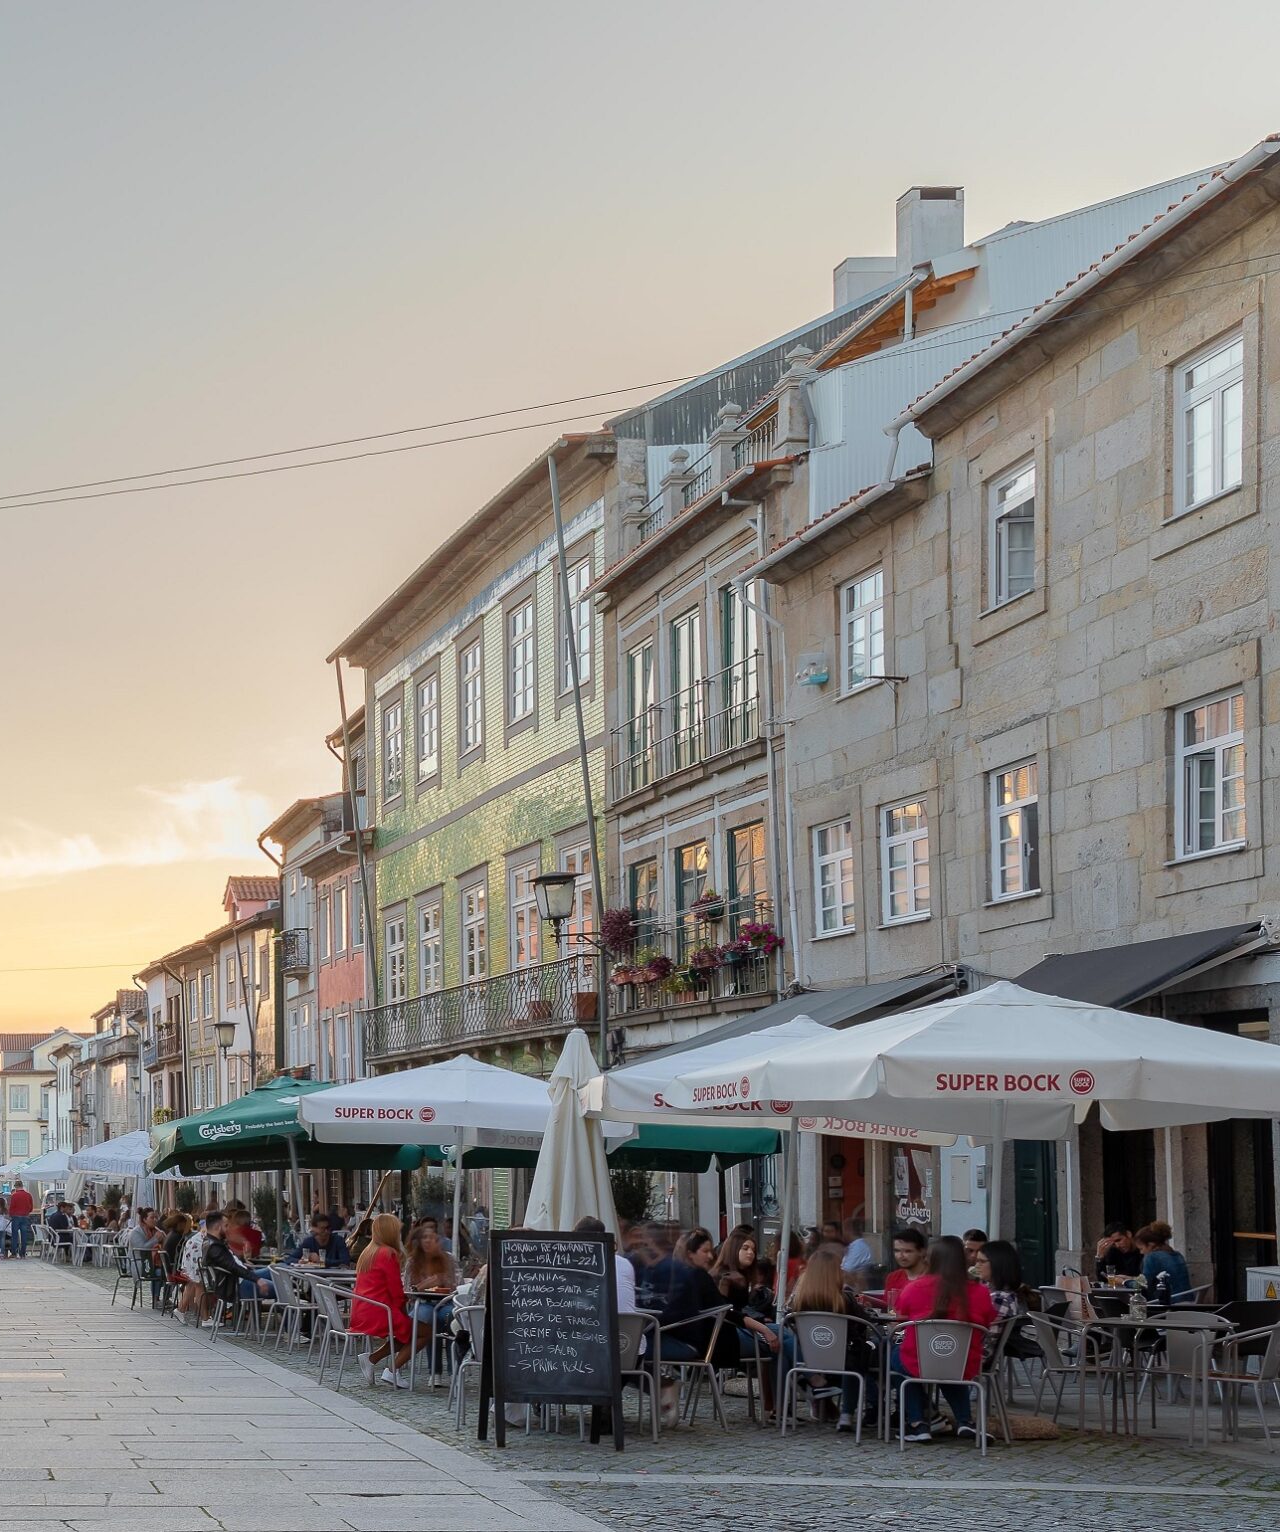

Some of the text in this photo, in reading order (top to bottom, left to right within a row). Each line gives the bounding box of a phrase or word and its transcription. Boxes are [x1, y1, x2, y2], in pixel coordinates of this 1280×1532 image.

[936, 1073, 1060, 1092] SUPER BOCK
[692, 1086, 715, 1102] SUPER
[716, 1081, 738, 1099] BOCK
[334, 1107, 374, 1119] SUPER
[377, 1108, 414, 1120] BOCK
[199, 1121, 241, 1140] Carlsberg
[194, 1159, 233, 1172] Carlsberg
[899, 1199, 931, 1224] Carlsberg
[557, 1285, 582, 1294] SANTA
[548, 1314, 562, 1323] DE
[565, 1315, 600, 1327] FRANGO
[556, 1329, 568, 1340] DE
[515, 1341, 578, 1357] TACO SALAD
